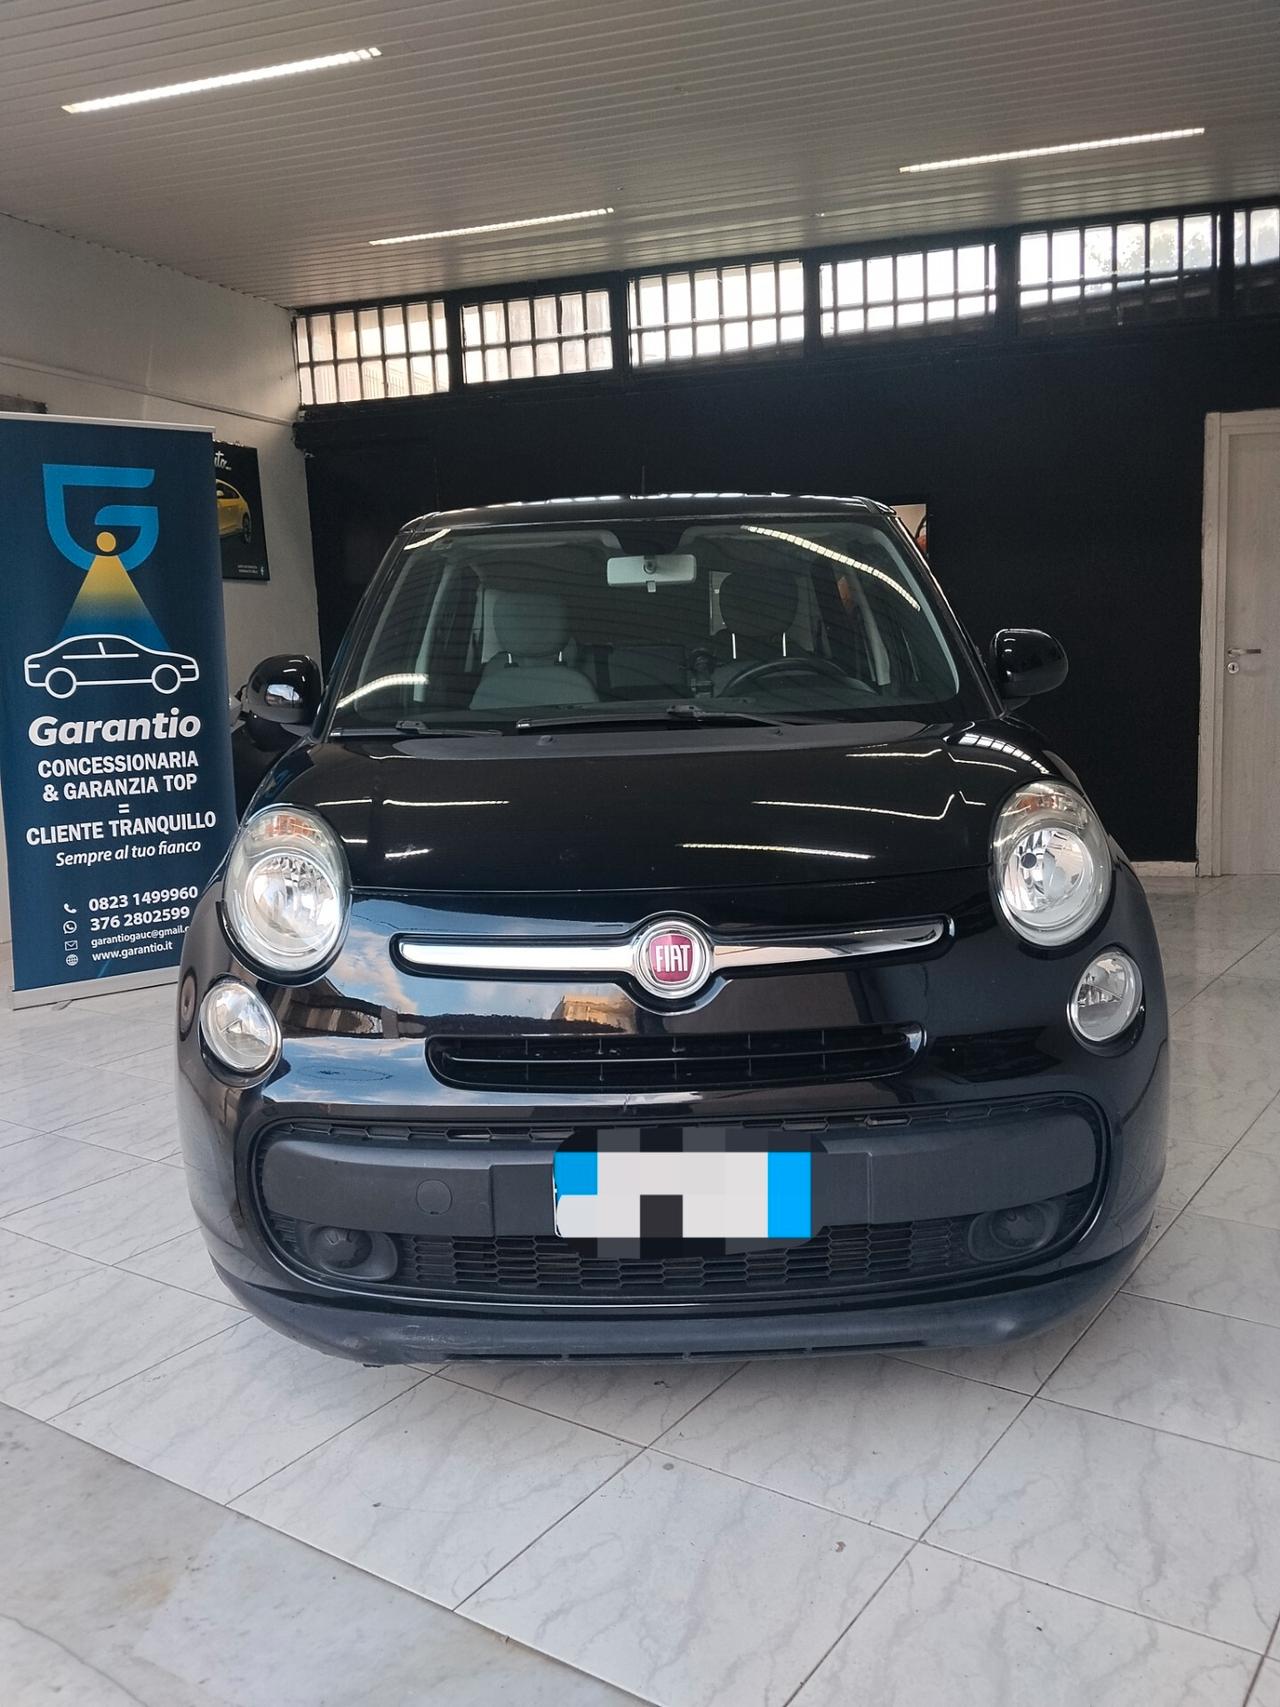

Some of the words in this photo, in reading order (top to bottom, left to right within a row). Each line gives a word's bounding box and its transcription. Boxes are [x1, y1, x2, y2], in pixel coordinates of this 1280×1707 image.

[28, 707, 201, 747] Garantio
[37, 750, 199, 778] CONCESSIONARIA
[42, 783, 59, 802] &
[63, 776, 159, 800] GARANZIA
[162, 773, 198, 792] TOP
[118, 803, 130, 814] =
[26, 821, 104, 846] CLIENTE
[108, 810, 217, 837] TRANQUILLO
[55, 848, 112, 867] Sempre
[114, 845, 129, 860] al
[131, 843, 156, 858] tuo
[158, 840, 201, 856] fianco
[88, 894, 129, 912] 0823
[132, 886, 198, 906] 1499960
[90, 915, 121, 932] 376
[123, 906, 190, 927] 2802599
[91, 925, 190, 949] garantiogauc@gmail.c
[92, 940, 173, 962] www.garantio.it
[655, 944, 690, 973] FIAT
